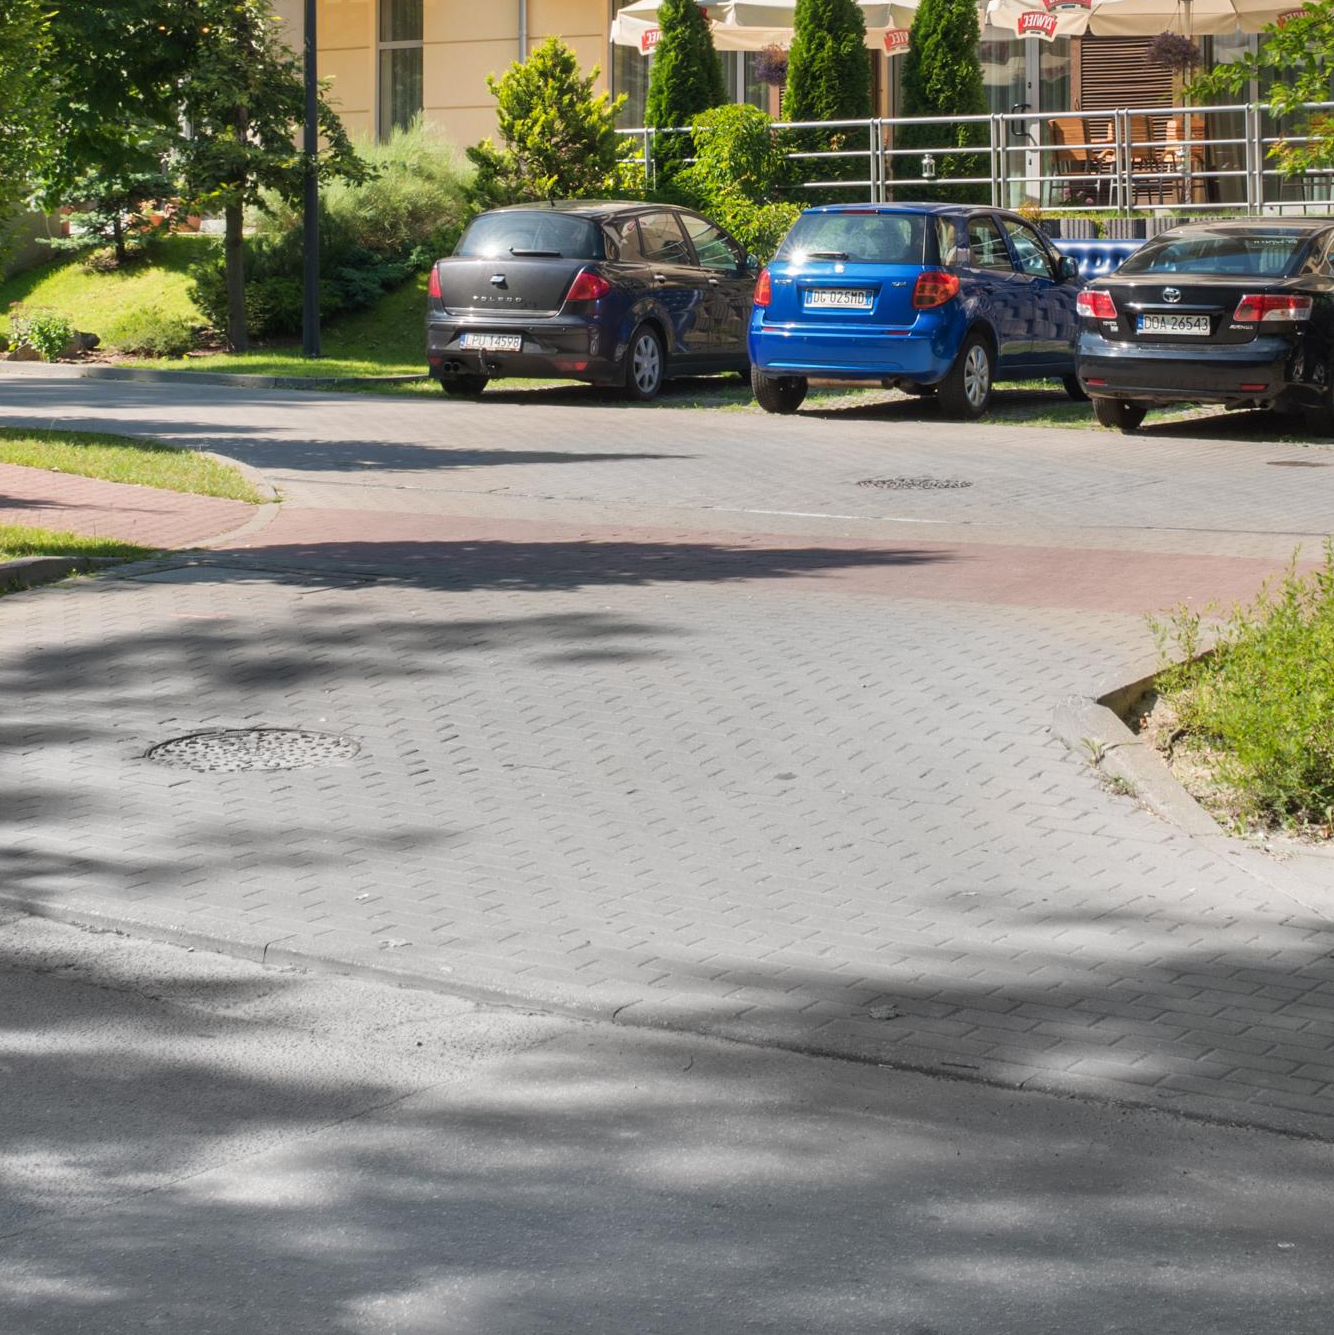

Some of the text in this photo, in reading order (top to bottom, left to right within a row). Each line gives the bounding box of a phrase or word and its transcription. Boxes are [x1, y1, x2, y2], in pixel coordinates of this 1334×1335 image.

[813, 290, 827, 303] DG
[1170, 316, 1209, 331] 26543
[489, 334, 520, 348] 14598
